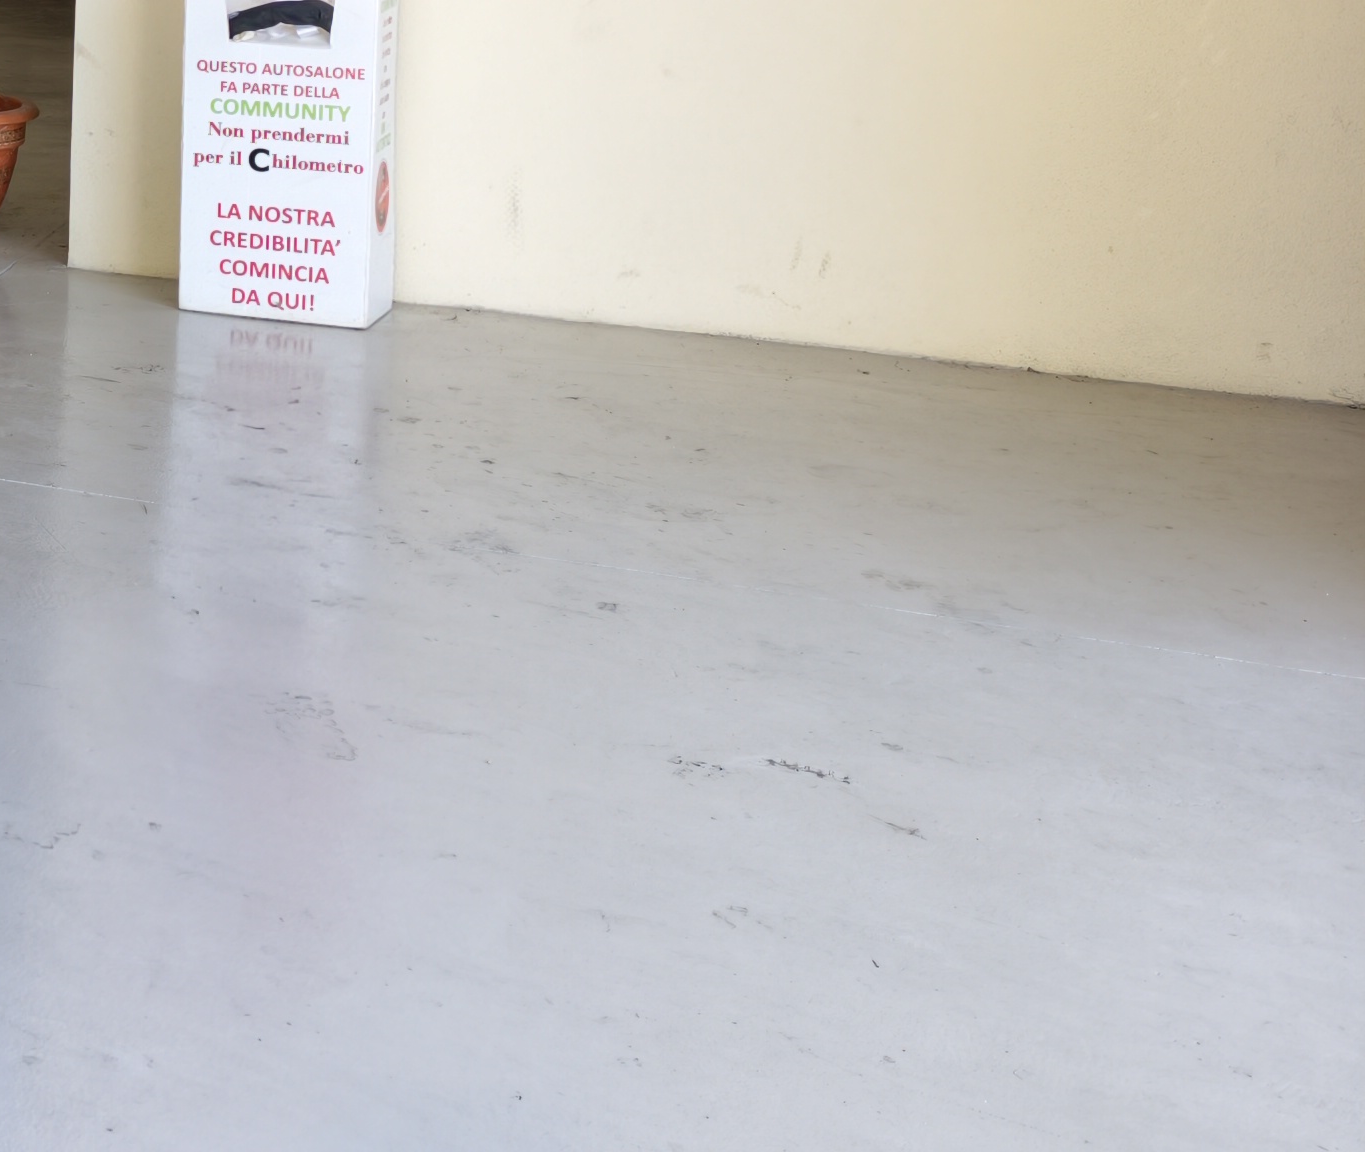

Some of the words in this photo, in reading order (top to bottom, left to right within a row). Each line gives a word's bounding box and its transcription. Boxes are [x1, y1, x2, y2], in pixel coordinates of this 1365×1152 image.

[197, 59, 257, 75] QUESTO
[261, 63, 366, 81] AUTOSALONE
[220, 81, 238, 94] FA
[242, 82, 289, 96] PARTE
[293, 86, 340, 99] DELLA
[210, 98, 351, 123] COMMUNITY
[207, 121, 245, 138] Non
[250, 123, 350, 145] prendermi
[193, 151, 224, 167] per
[229, 151, 242, 166] il
[248, 148, 364, 175] Chilometro
[217, 202, 242, 220] LA
[248, 205, 336, 228] NOSTRA
[209, 230, 341, 257] CREDIBILITA'
[219, 259, 330, 285] COMINCIA
[231, 288, 261, 306] DA
[267, 291, 315, 311] QUI!
